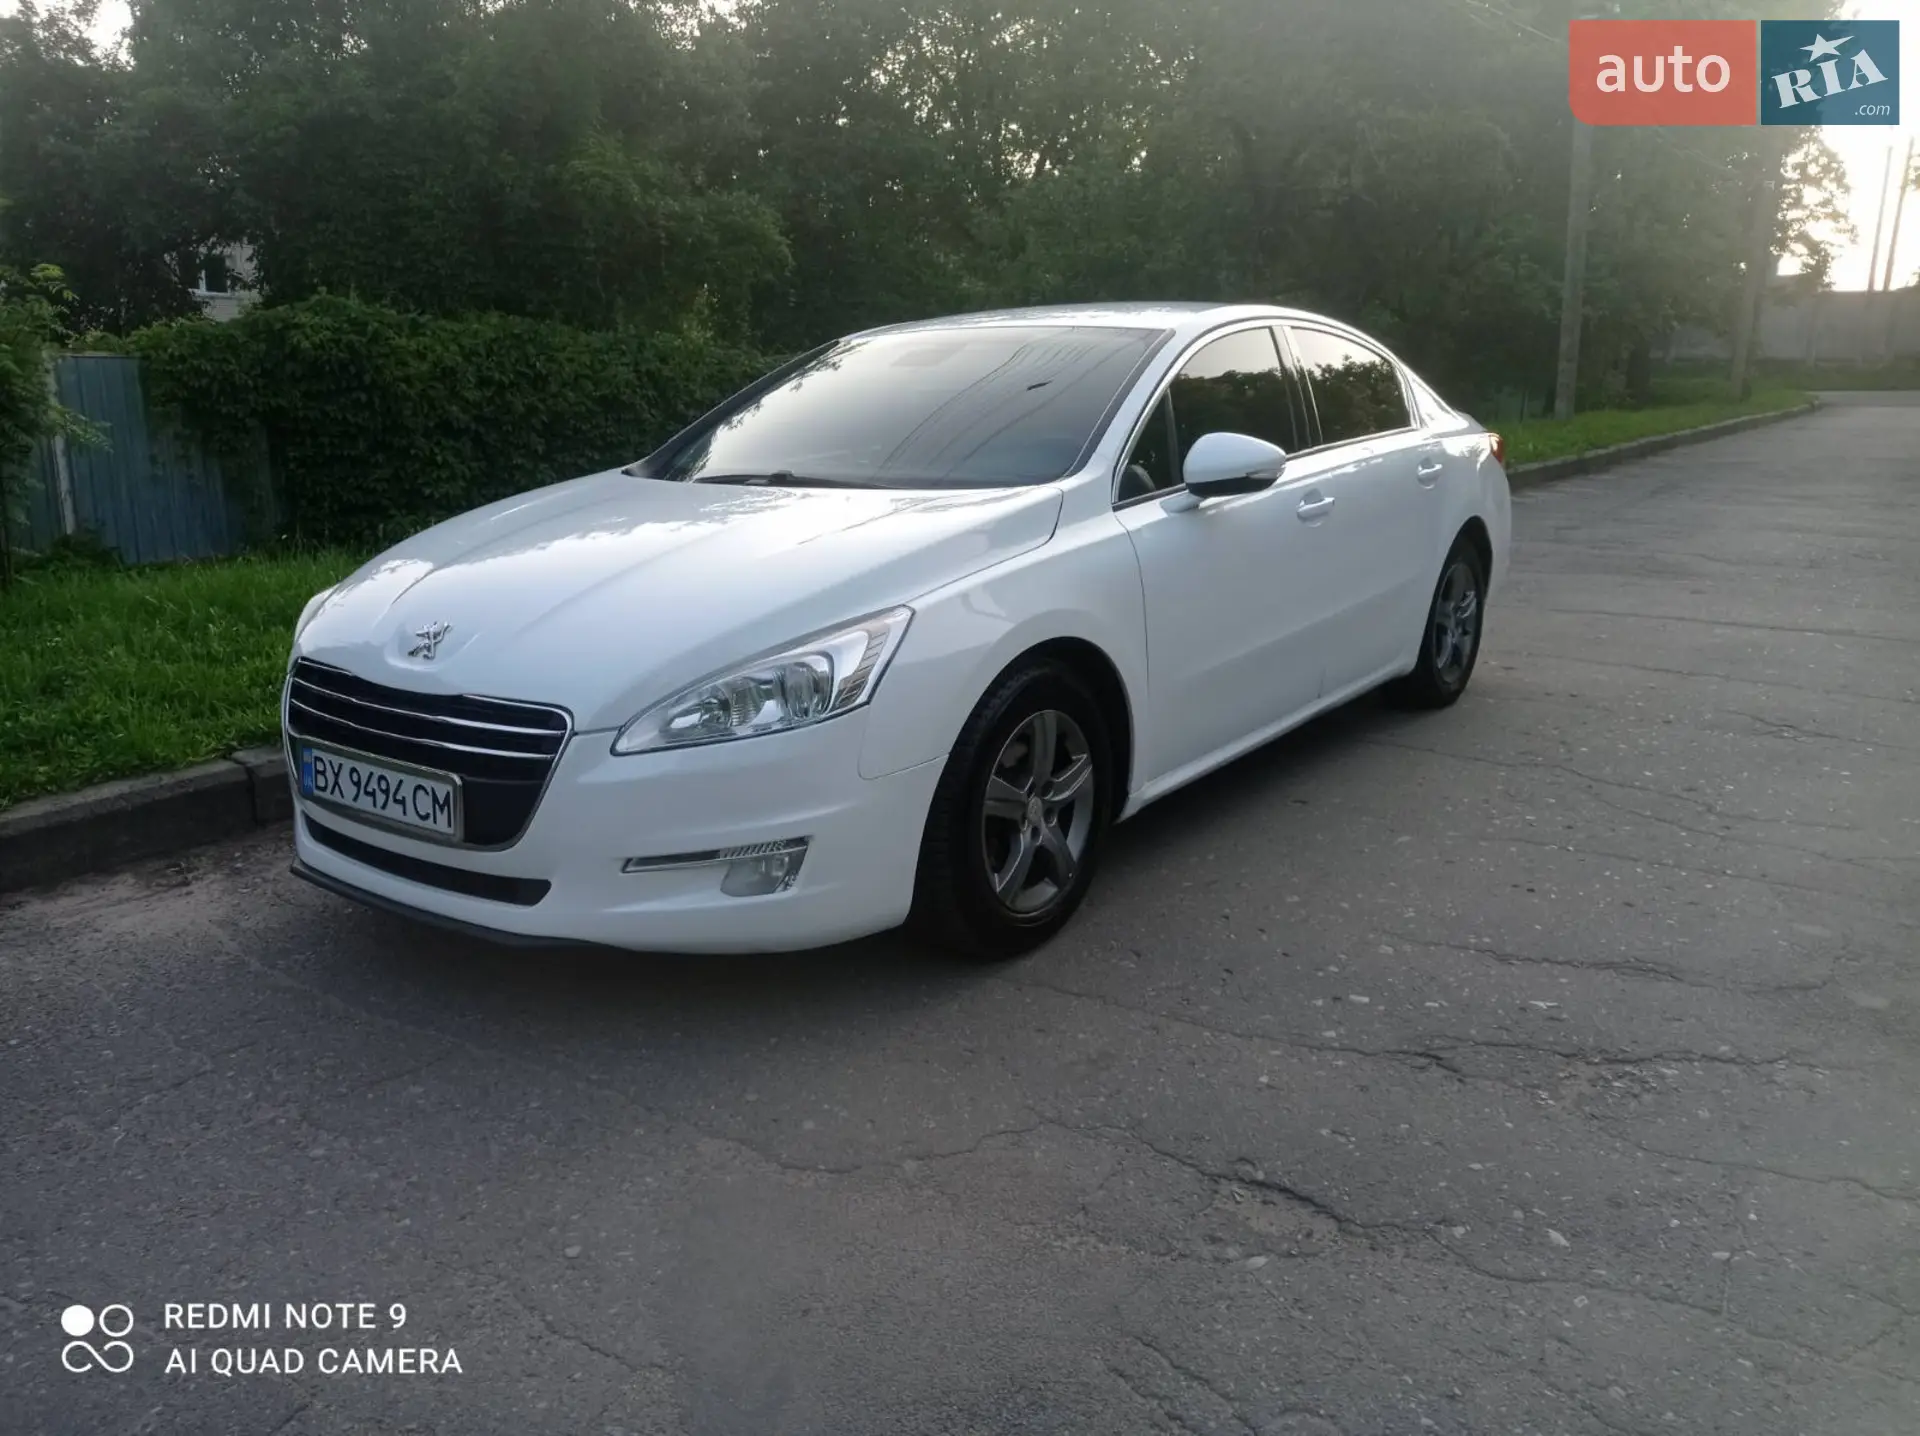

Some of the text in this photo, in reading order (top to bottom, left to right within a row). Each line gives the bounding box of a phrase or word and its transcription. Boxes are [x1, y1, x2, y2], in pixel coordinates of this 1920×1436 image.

[314, 755, 452, 829] BX 9494 CM
